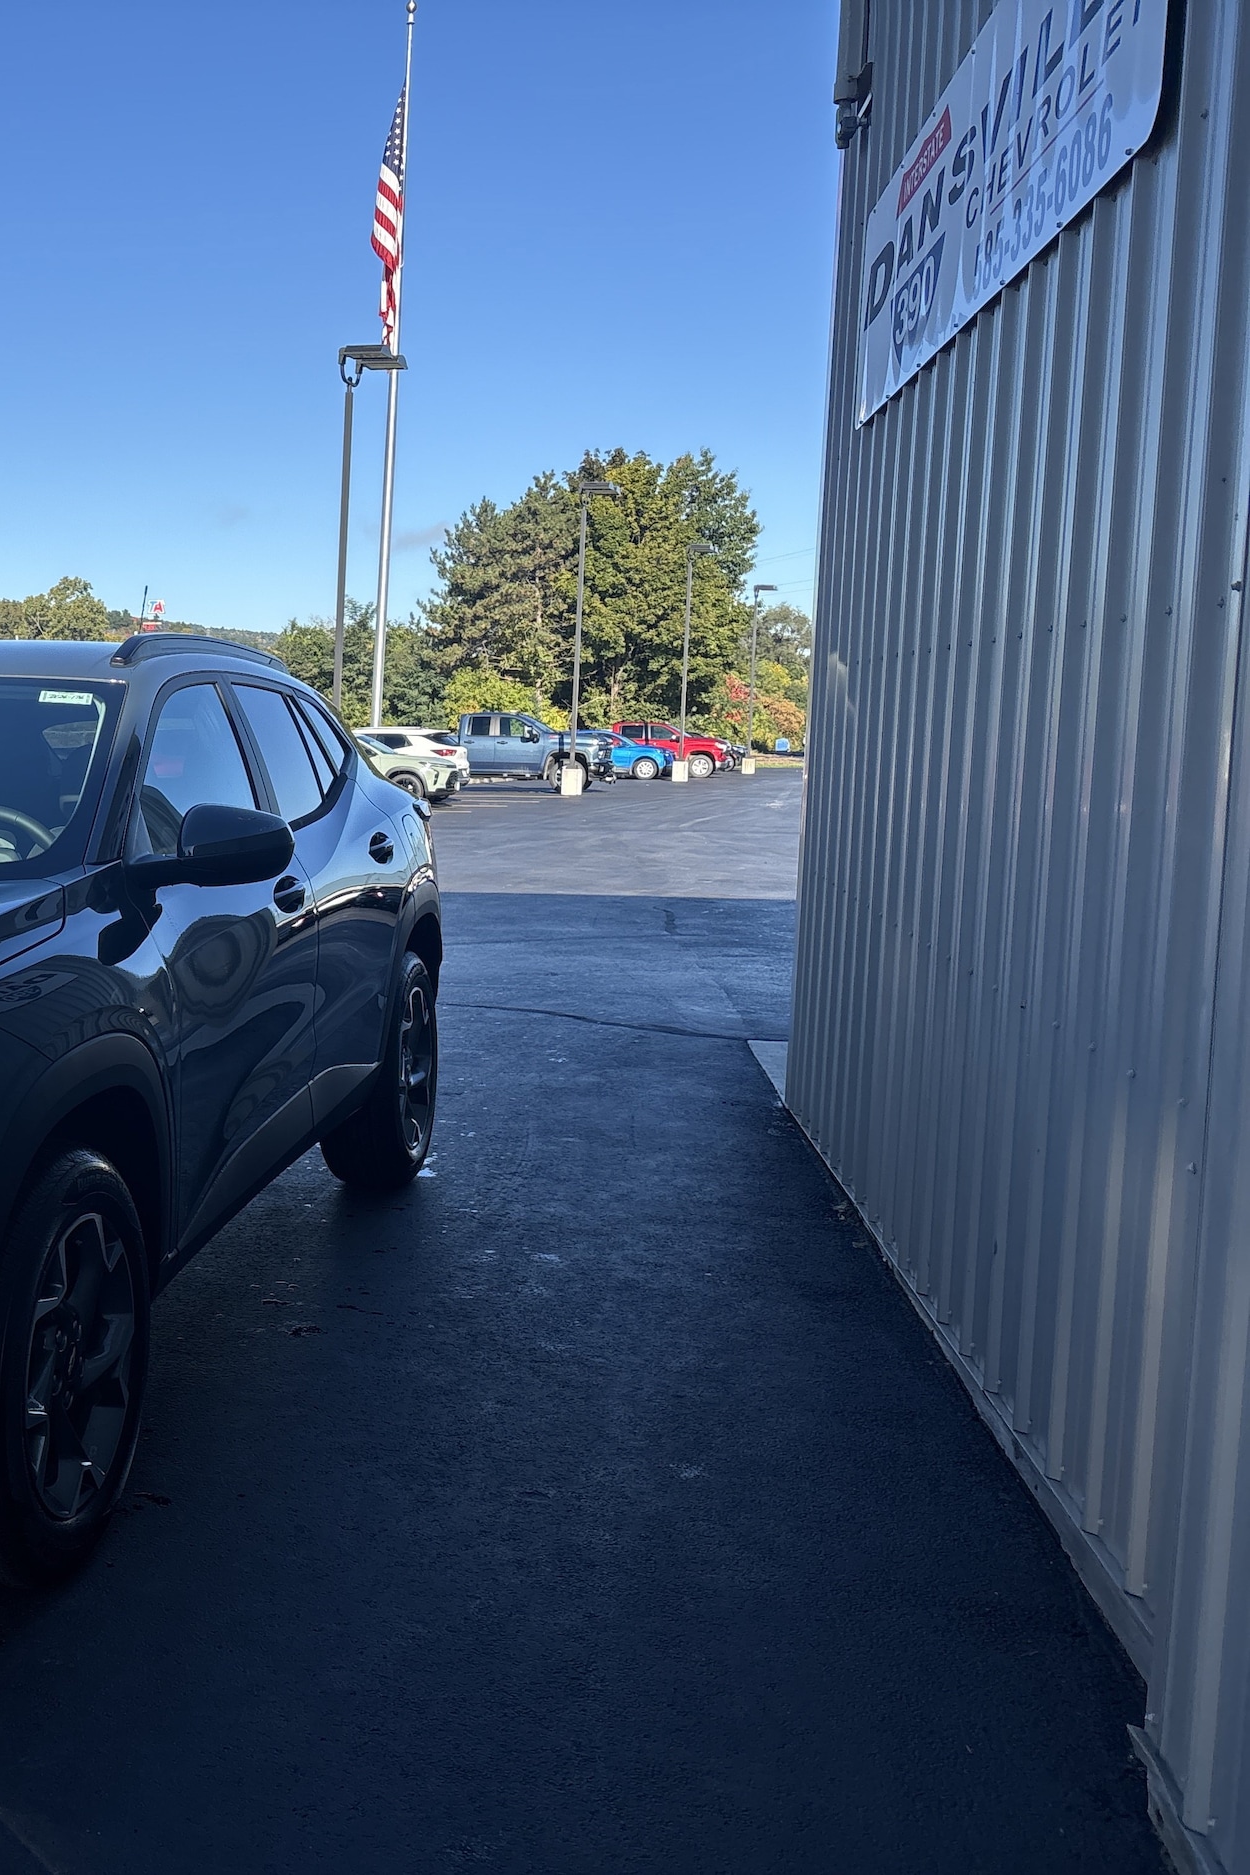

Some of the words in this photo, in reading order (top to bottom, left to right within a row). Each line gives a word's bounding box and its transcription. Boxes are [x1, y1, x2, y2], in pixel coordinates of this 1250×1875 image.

[902, 123, 945, 203] INTERSTATE
[973, 93, 1114, 300] 585-335-6086
[894, 255, 935, 345] 390
[149, 600, 163, 613] TA
